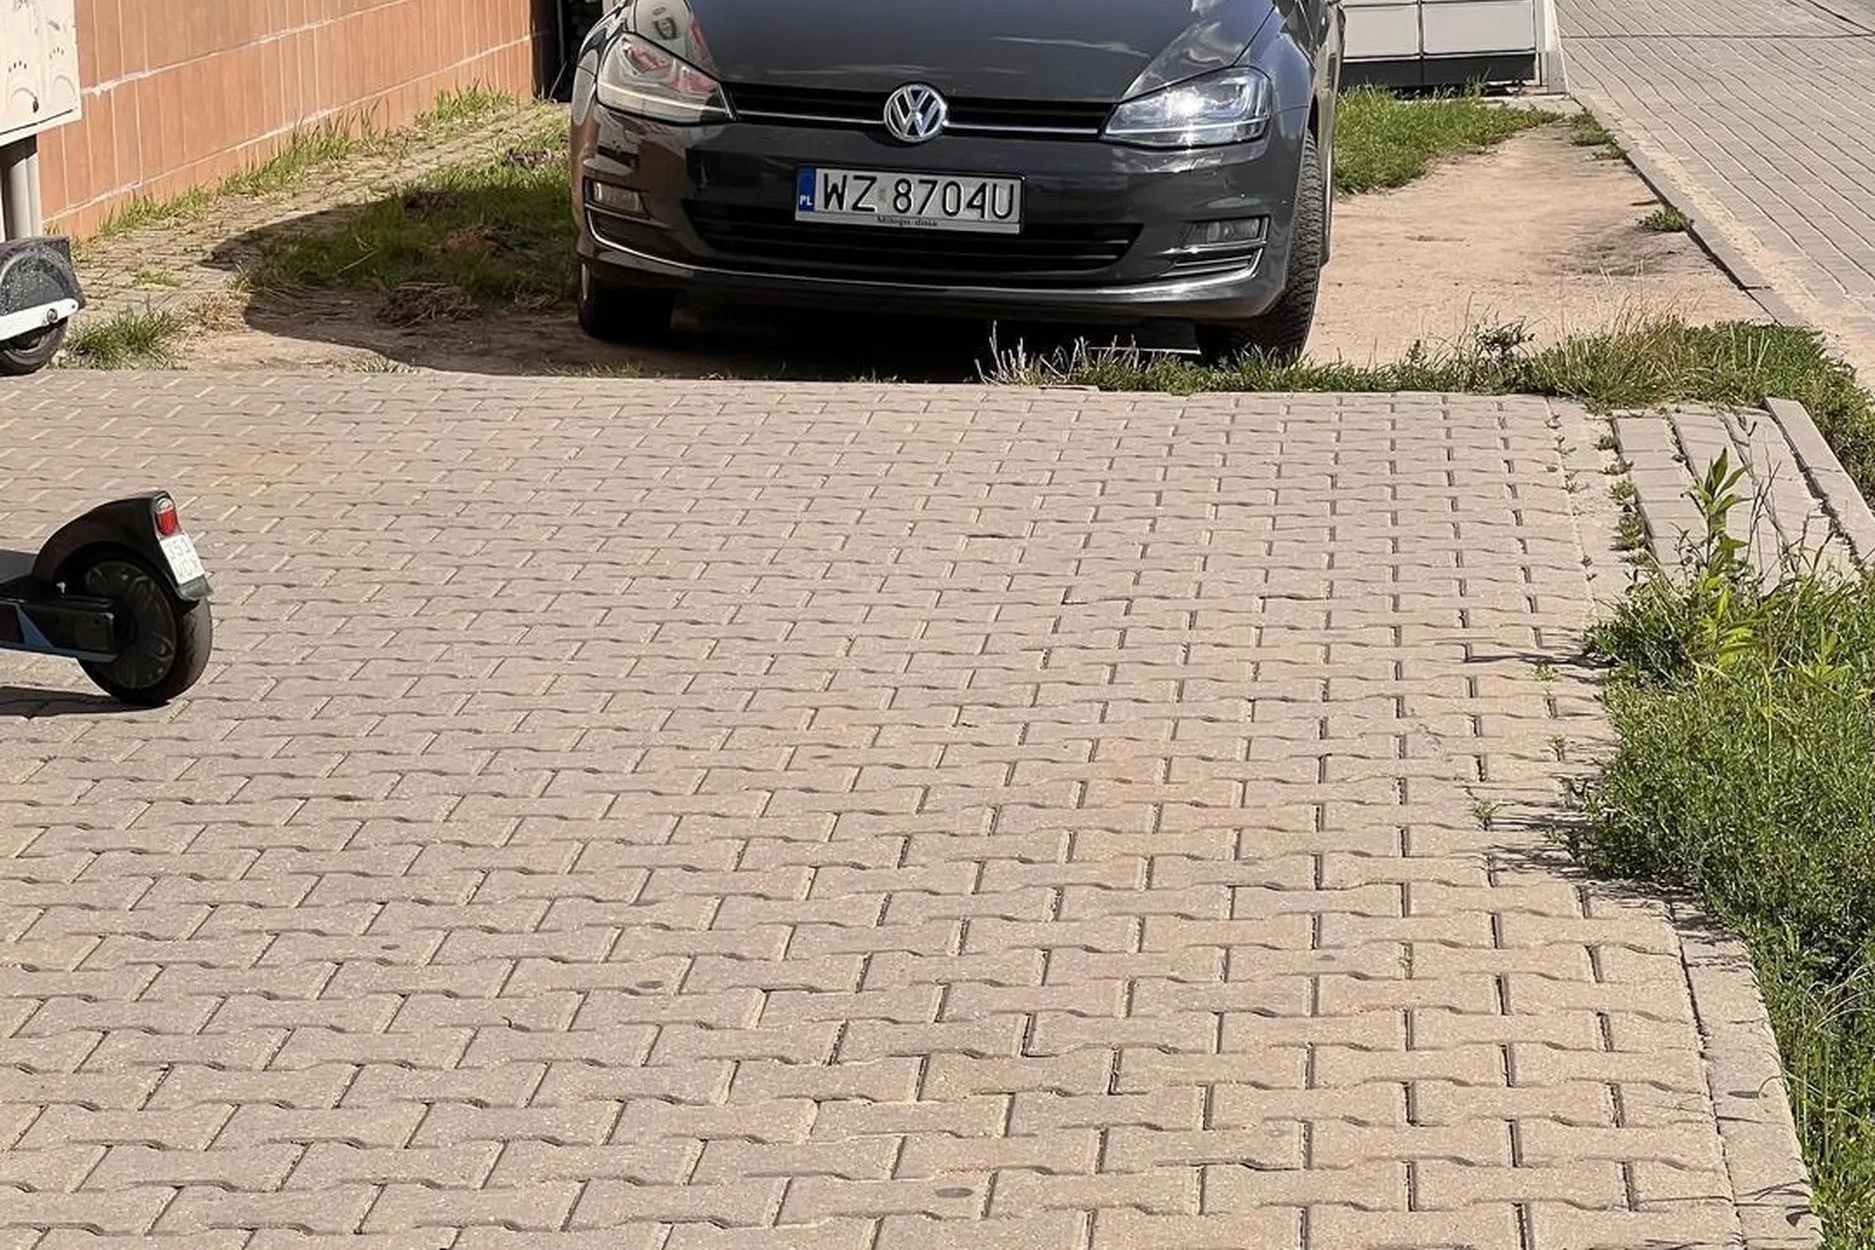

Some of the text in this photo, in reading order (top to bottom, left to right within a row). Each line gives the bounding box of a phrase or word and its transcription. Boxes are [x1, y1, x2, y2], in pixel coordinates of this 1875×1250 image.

[799, 173, 1015, 220] PL WZ 8704U
